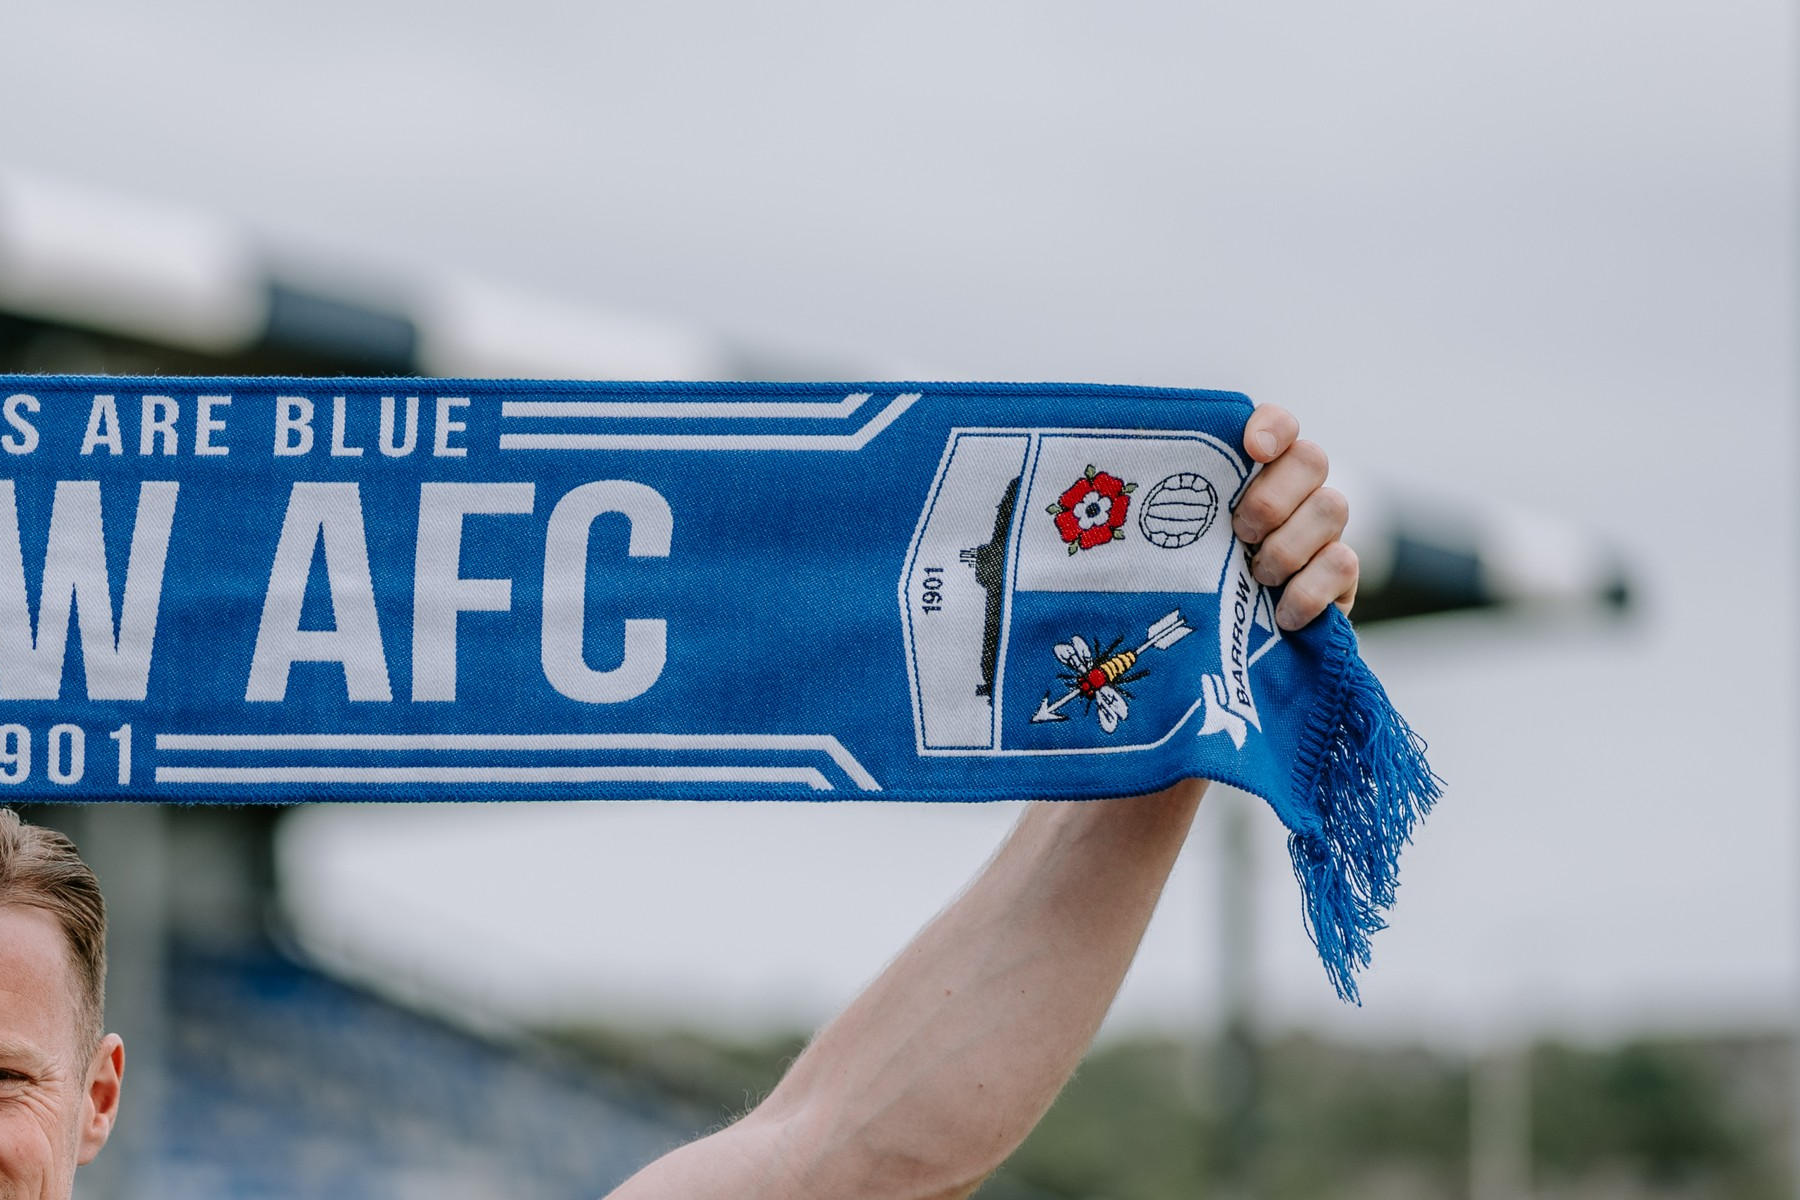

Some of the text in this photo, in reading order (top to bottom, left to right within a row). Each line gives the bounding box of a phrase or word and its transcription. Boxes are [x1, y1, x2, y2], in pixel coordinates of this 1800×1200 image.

[80, 394, 232, 457] ARE
[273, 396, 471, 458] BLUE
[244, 479, 675, 704] AFC
[921, 566, 944, 615] 1901
[1230, 571, 1253, 707] BARROW
